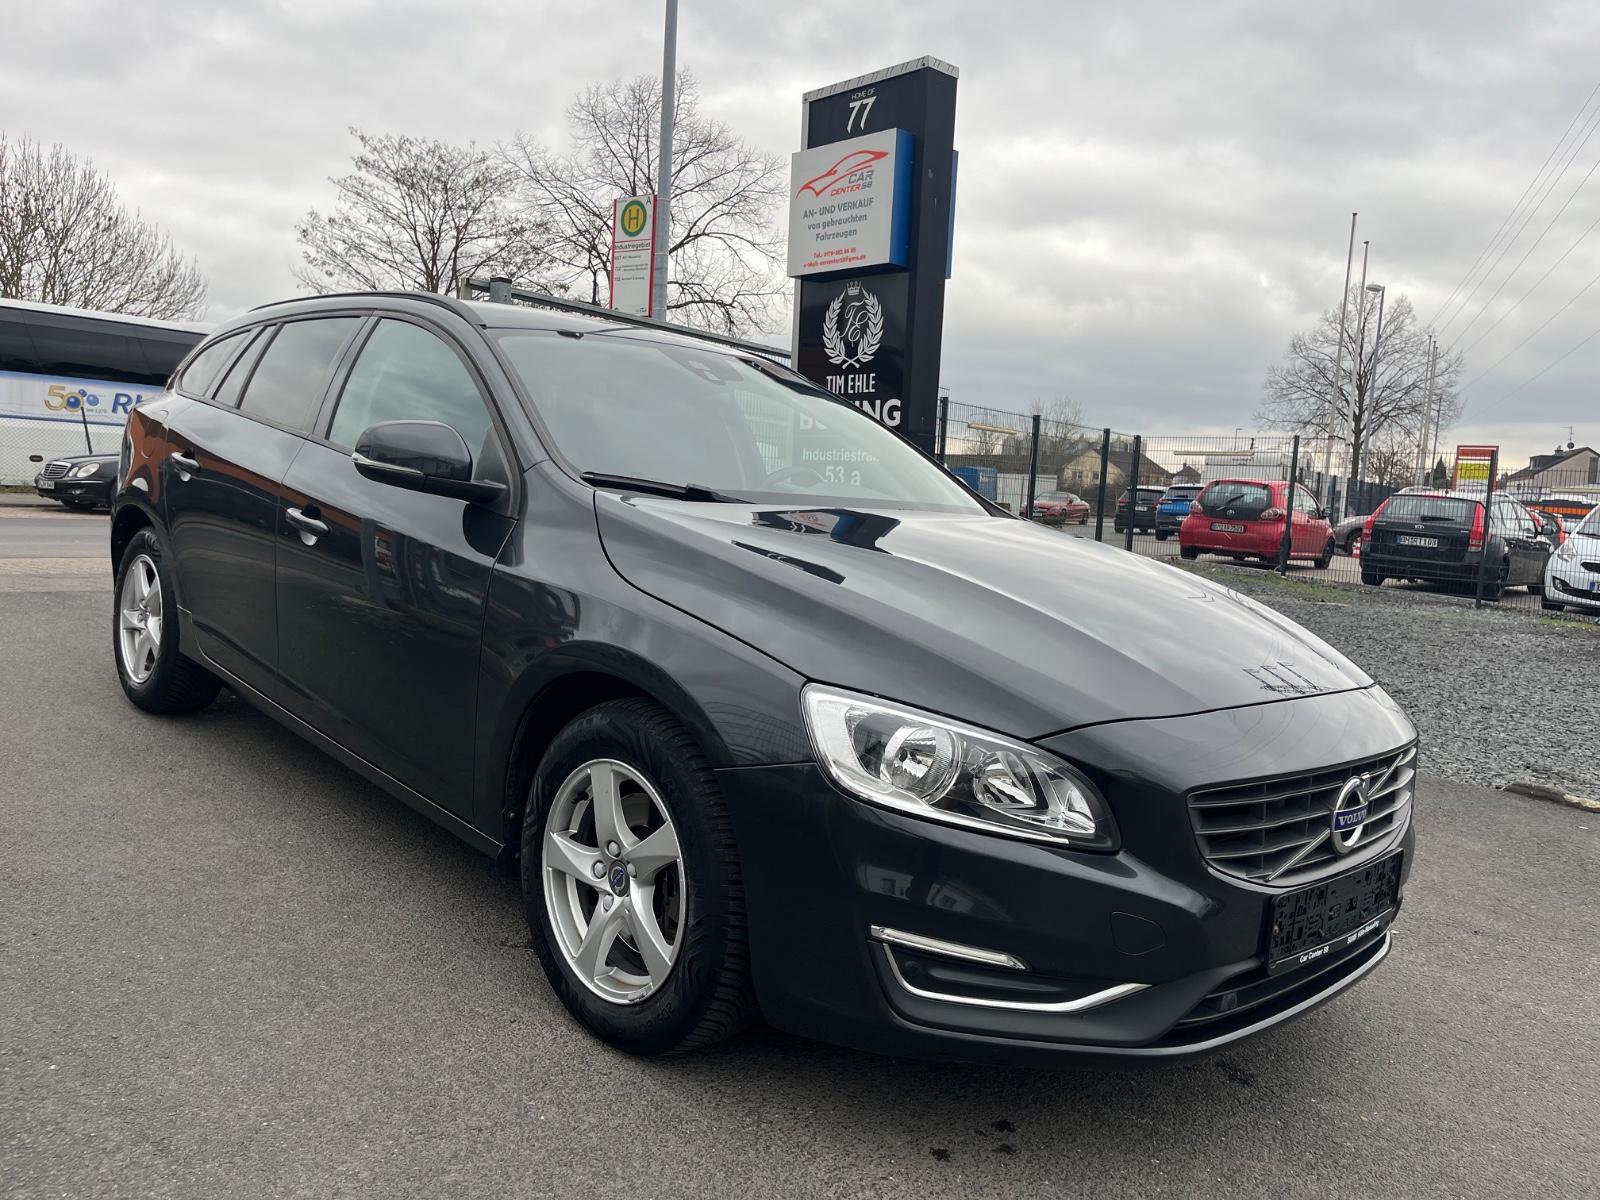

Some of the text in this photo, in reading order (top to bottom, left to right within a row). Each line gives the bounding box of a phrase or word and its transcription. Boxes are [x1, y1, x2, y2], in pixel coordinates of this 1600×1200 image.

[851, 87, 876, 100] HOME OF
[847, 96, 878, 134] 77
[848, 170, 874, 184] CAR
[645, 196, 652, 206] A
[803, 198, 875, 220] AN- UND VERKAUF
[627, 207, 640, 230] H
[808, 213, 868, 230] von gebrauchten
[815, 228, 857, 242] Fahrzeugen
[826, 373, 876, 394] TIM EHLE
[825, 465, 861, 486] 53 a
[1337, 809, 1367, 827] VOLVO
[1309, 948, 1323, 960] Center
